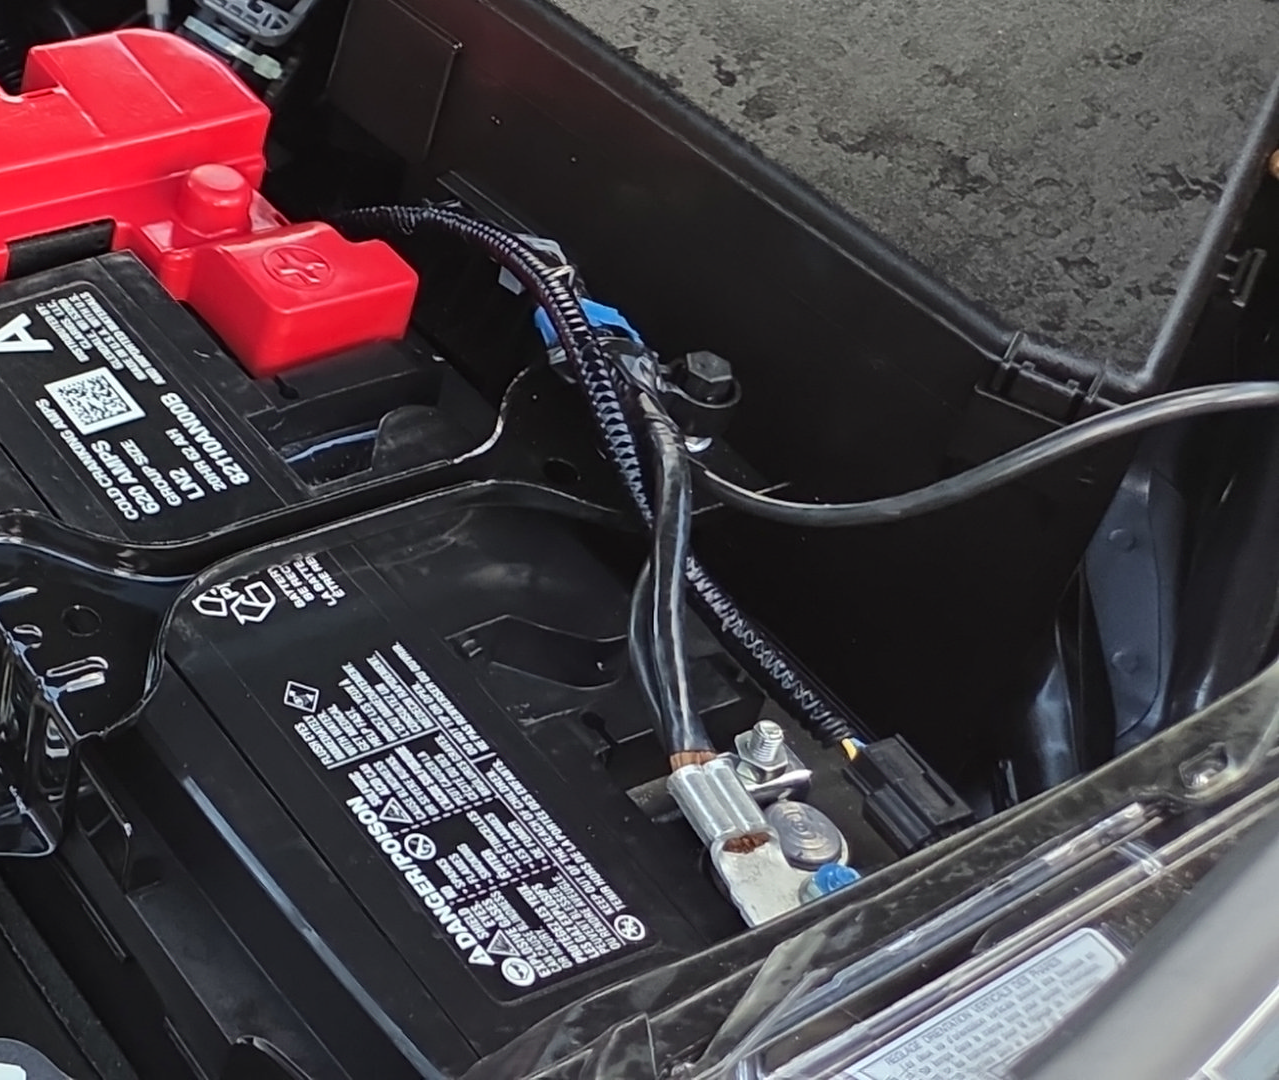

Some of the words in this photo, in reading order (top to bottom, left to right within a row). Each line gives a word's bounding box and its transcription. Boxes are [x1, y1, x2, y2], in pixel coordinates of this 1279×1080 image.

[79, 307, 101, 327] WITH
[80, 291, 119, 332] MATERIALS
[46, 317, 89, 362] DISTRIBUTED
[114, 330, 151, 368] IMPORTED
[114, 348, 128, 357] IN
[121, 355, 147, 380] MADE
[145, 367, 166, 384] AND
[35, 398, 67, 429] AMPS
[161, 393, 249, 484] 82110AN00B
[165, 428, 189, 446] AH
[60, 429, 112, 487] CRANKING
[91, 440, 138, 483] AMPS
[120, 439, 148, 465] SIZE
[181, 444, 200, 461] 62
[169, 467, 204, 499] LN2
[193, 460, 227, 491] 20HR
[141, 466, 181, 506] GROUP
[106, 487, 139, 520] COLD
[128, 485, 160, 514] 620
[297, 586, 314, 601] BE
[321, 590, 337, 606] LA
[415, 670, 430, 683] OU
[344, 684, 365, 704] YEUX
[374, 683, 390, 695] UN
[360, 702, 377, 717] LES
[383, 694, 422, 733] CONSULTEZ
[425, 682, 466, 725] RENVERSER
[428, 703, 443, 715] OR
[327, 704, 358, 736] MEDICAL
[438, 715, 454, 728] TIP
[295, 722, 315, 741] EYES
[303, 715, 346, 760] IMMEDIATELY
[360, 728, 383, 747] HELP
[448, 728, 468, 743] NOT
[461, 724, 480, 740] PAS
[308, 740, 334, 765] FLUSH
[336, 736, 358, 755] WITH
[351, 736, 370, 751] GET
[462, 743, 478, 755] DO
[473, 739, 489, 751] NE
[417, 751, 430, 762] LA
[434, 753, 451, 768] DES
[359, 763, 377, 778] CAN
[373, 761, 409, 798] BLINDNESS
[424, 760, 452, 787] CAUSER
[445, 766, 460, 778] OU
[370, 777, 391, 796] ACID
[403, 778, 430, 805] SEVERE
[445, 787, 467, 805] PEUT
[402, 797, 426, 820] CAUSE
[424, 803, 439, 815] OR
[521, 794, 539, 810] DES
[518, 810, 534, 821] OF
[484, 812, 520, 849] FLAMMES
[508, 820, 535, 847] FUMER
[528, 819, 557, 848] REACH
[529, 847, 545, 859] DE
[551, 846, 570, 864] THE
[561, 839, 576, 852] LA
[457, 843, 491, 879] SMOKING
[501, 853, 520, 869] LES
[514, 848, 533, 864] LES
[570, 851, 586, 863] DE
[347, 797, 477, 949] DANGER/POISON
[435, 858, 466, 889] SPARKS
[448, 853, 479, 884] FLAMES
[564, 864, 581, 876] OF
[580, 862, 606, 886] HORS
[440, 885, 458, 900] NO
[574, 876, 596, 893] OUT
[531, 883, 573, 926] EXPLOSIFS
[549, 886, 582, 920] BLESSER
[590, 894, 615, 915] KEEP
[600, 885, 626, 911] TENIR
[470, 900, 496, 928] EYES.
[481, 898, 511, 928] GASES
[490, 890, 529, 931] BLINDNESS
[534, 905, 554, 922] LES
[458, 907, 489, 940] SHIELD
[579, 907, 611, 938] RENDRE
[522, 930, 549, 956] CAUSE
[534, 926, 563, 956] INJURY.
[546, 921, 588, 963] PROTÉGEZ
[565, 924, 586, 942] GAZ
[575, 920, 610, 954] PEUVENT
[504, 927, 551, 977] EXPLOSIVE
[580, 941, 600, 958] LES
[605, 937, 621, 950] OU
[543, 955, 562, 973] CAN
[557, 955, 573, 968] OR
